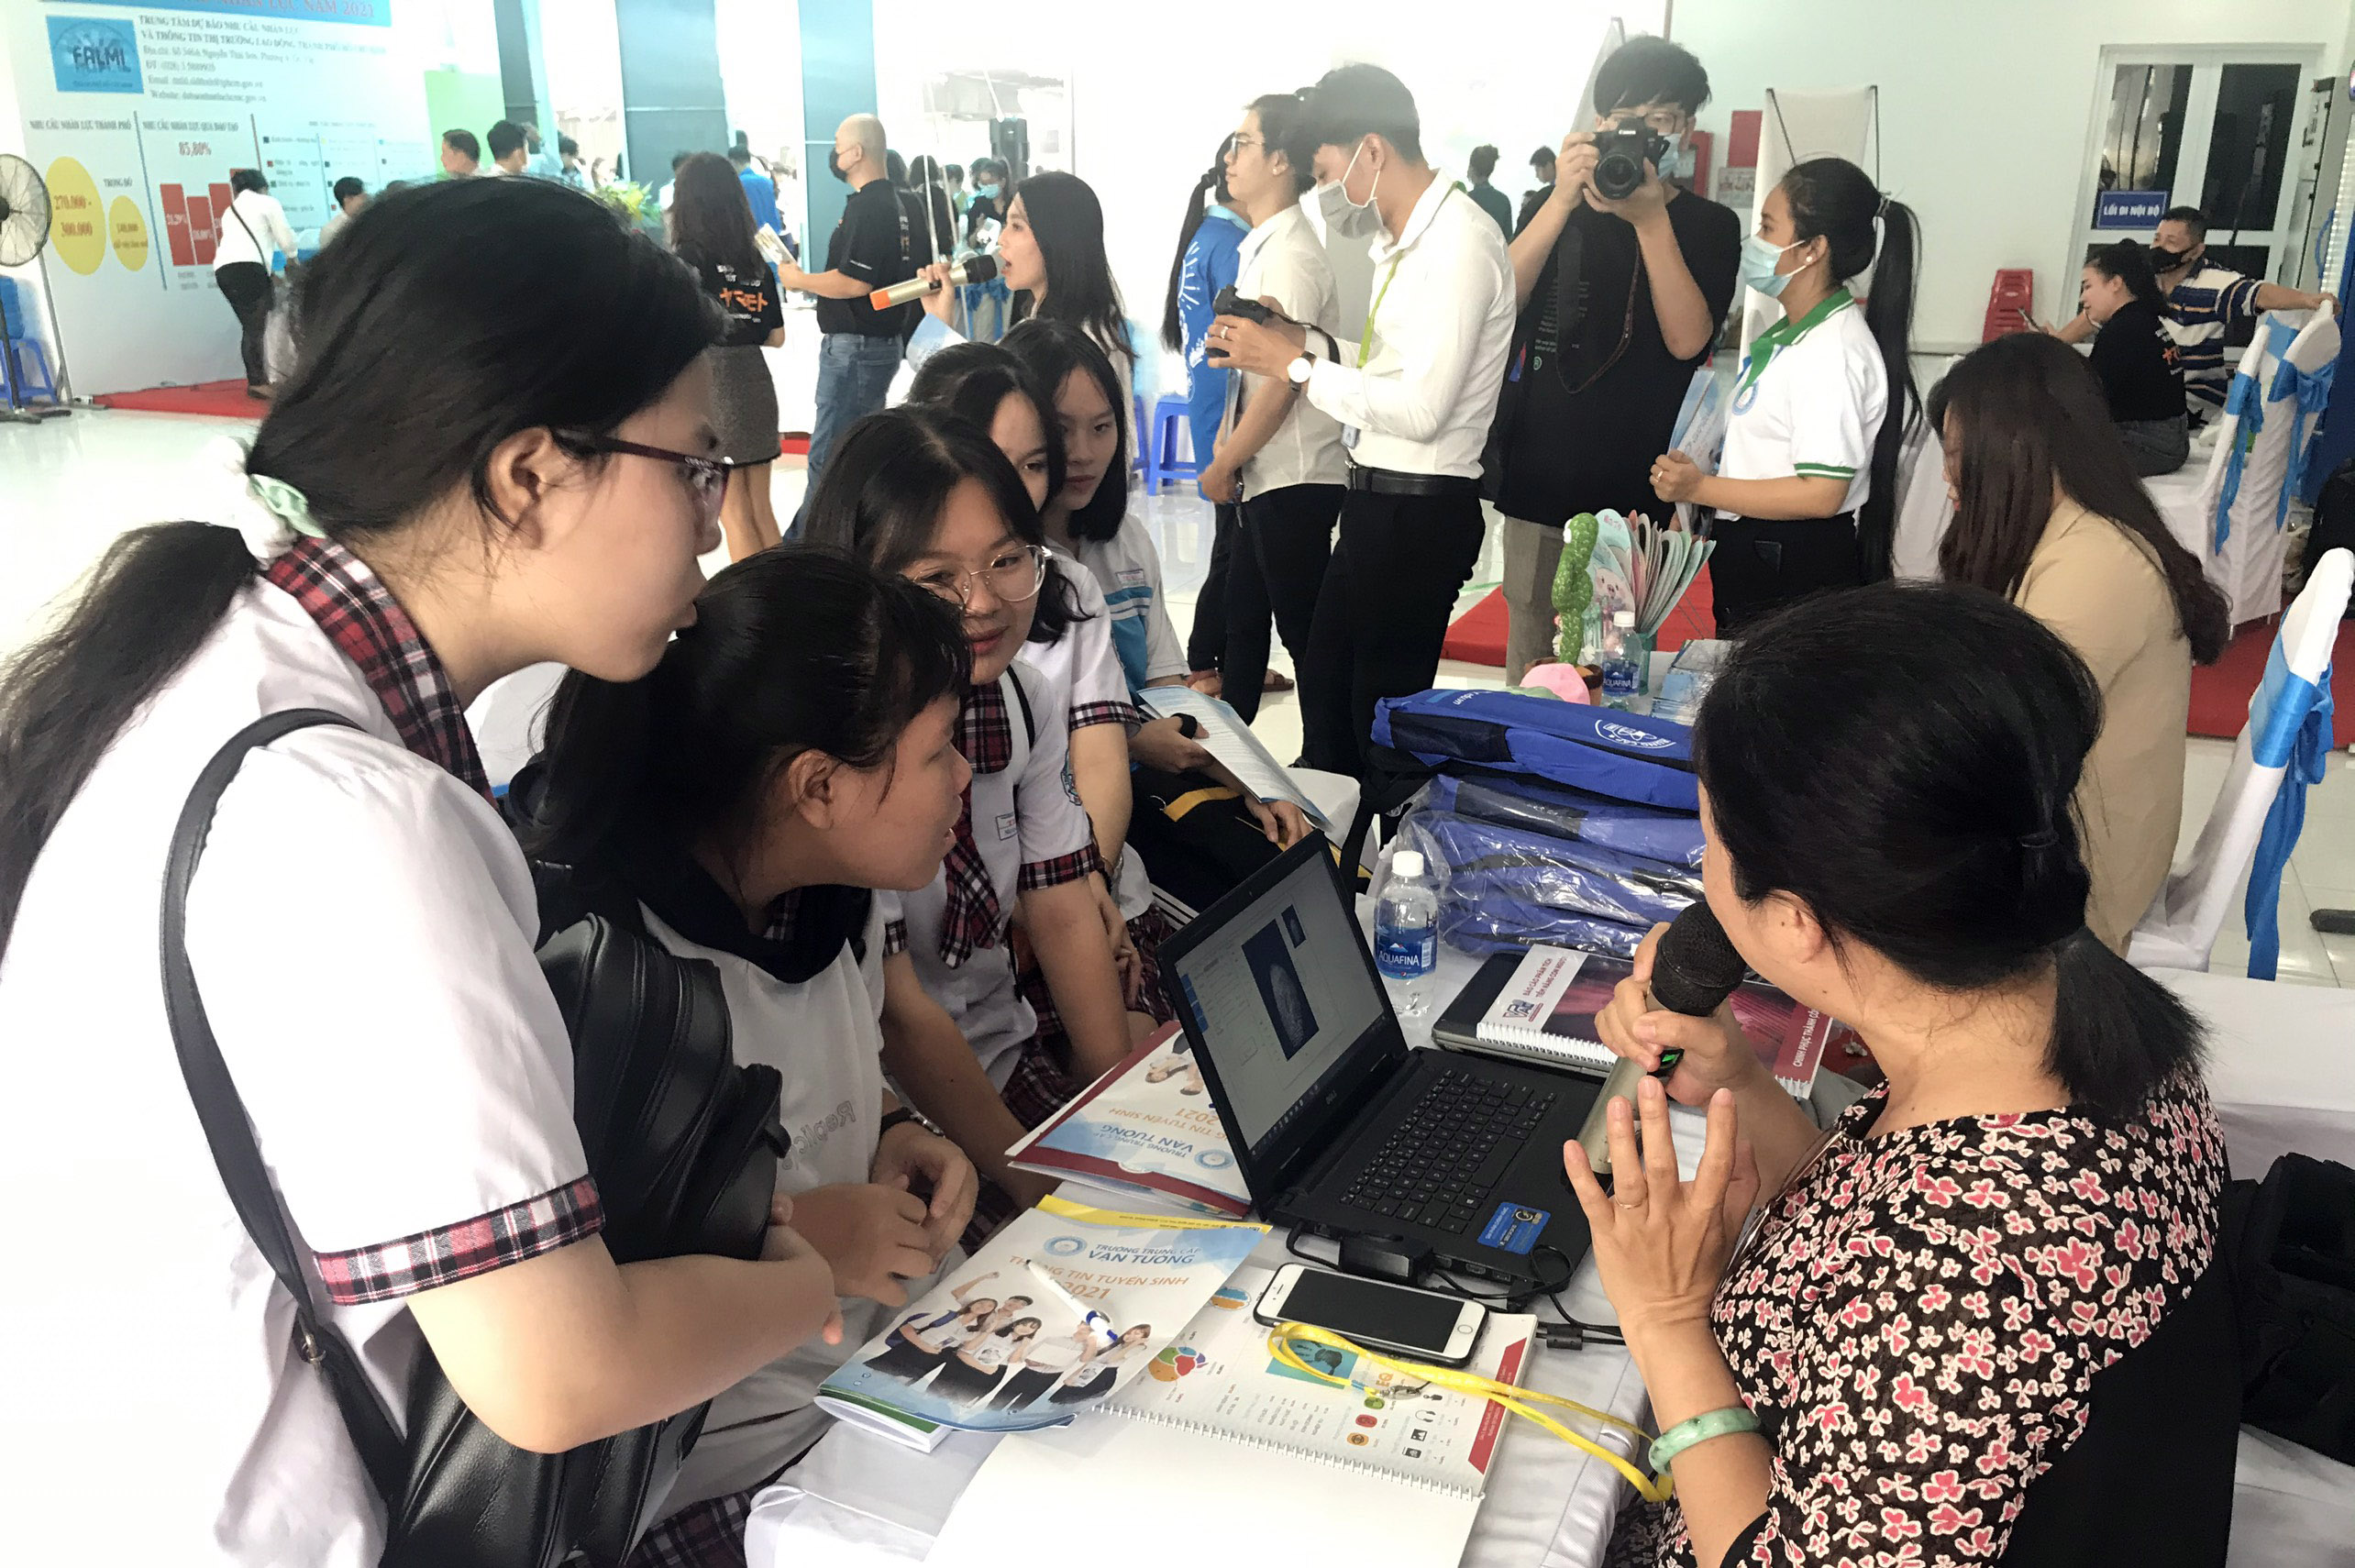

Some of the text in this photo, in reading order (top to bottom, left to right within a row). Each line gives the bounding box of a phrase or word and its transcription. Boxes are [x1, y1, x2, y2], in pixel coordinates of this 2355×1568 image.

[344, 3, 374, 17] 2021
[2130, 204, 2146, 217] NỘI
[1378, 951, 1420, 966] AQUAFINA
[1109, 1108, 1139, 1119] SINH
[1175, 1108, 1219, 1125] 2021
[1190, 1124, 1212, 1135] TIN
[1067, 1270, 1094, 1280] TIN
[1376, 1373, 1394, 1387] EQ
